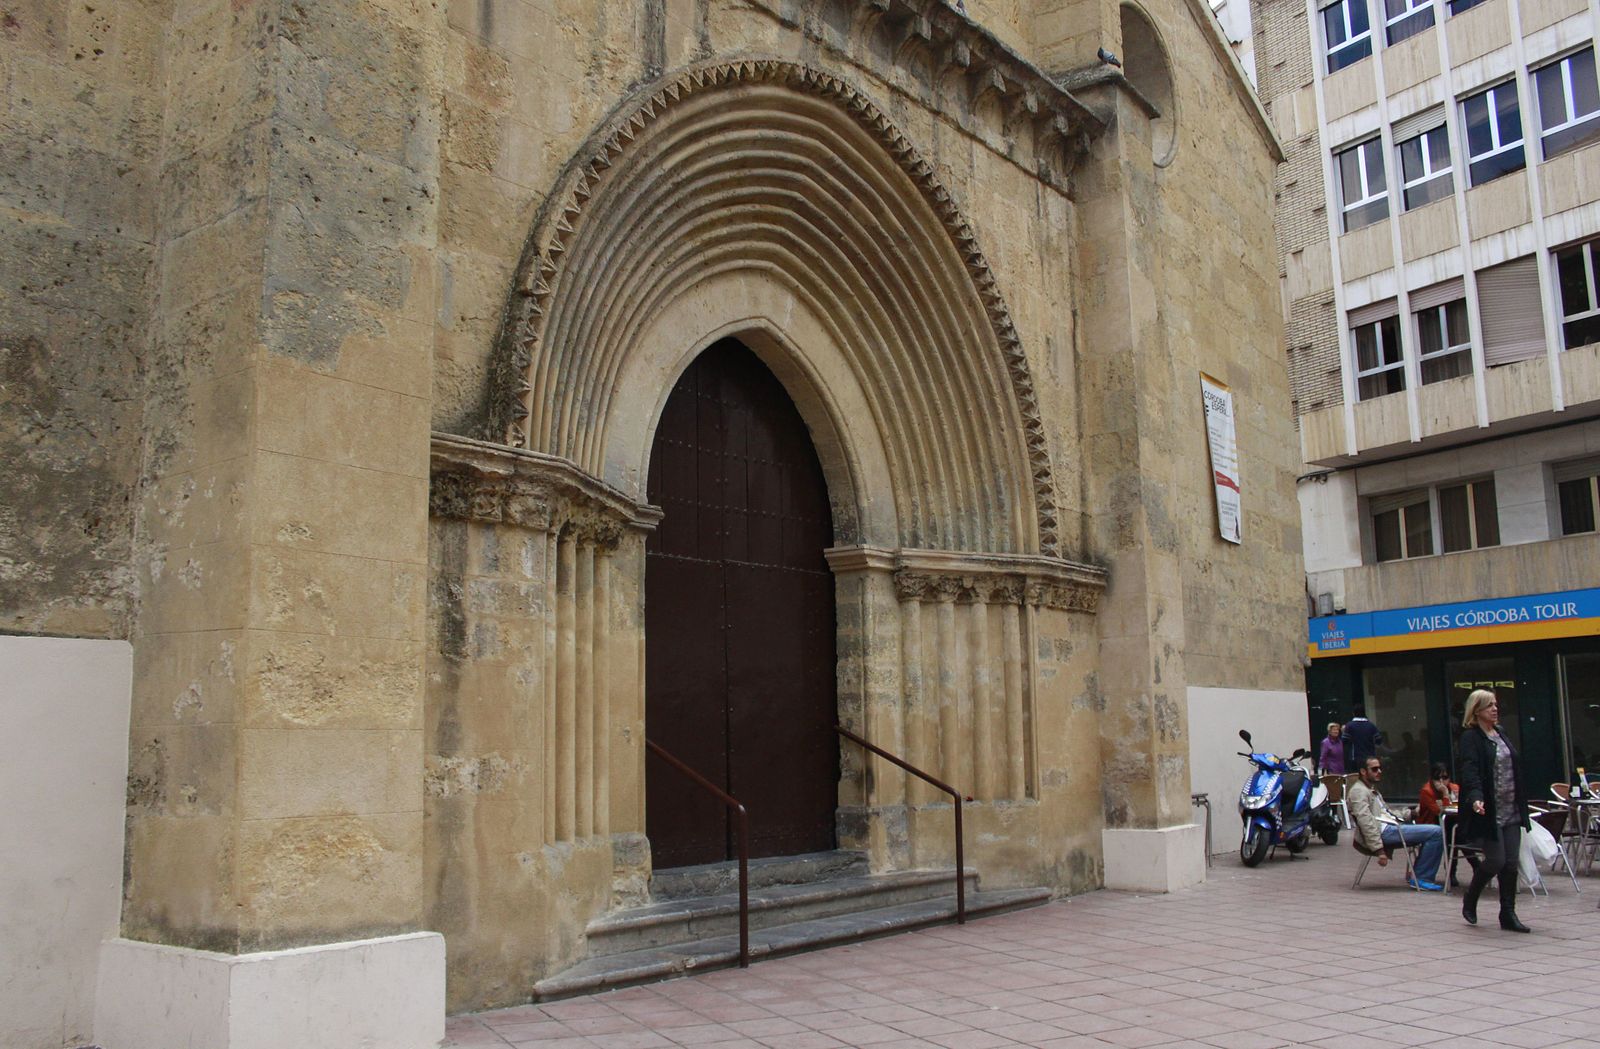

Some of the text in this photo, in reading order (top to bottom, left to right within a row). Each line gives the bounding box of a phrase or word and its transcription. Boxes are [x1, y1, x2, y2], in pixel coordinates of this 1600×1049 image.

[1407, 602, 1578, 632] VIAJES CÓRDOBA TOUR
[1321, 630, 1345, 640] VIAJES
[1322, 640, 1346, 649] IBERIA
